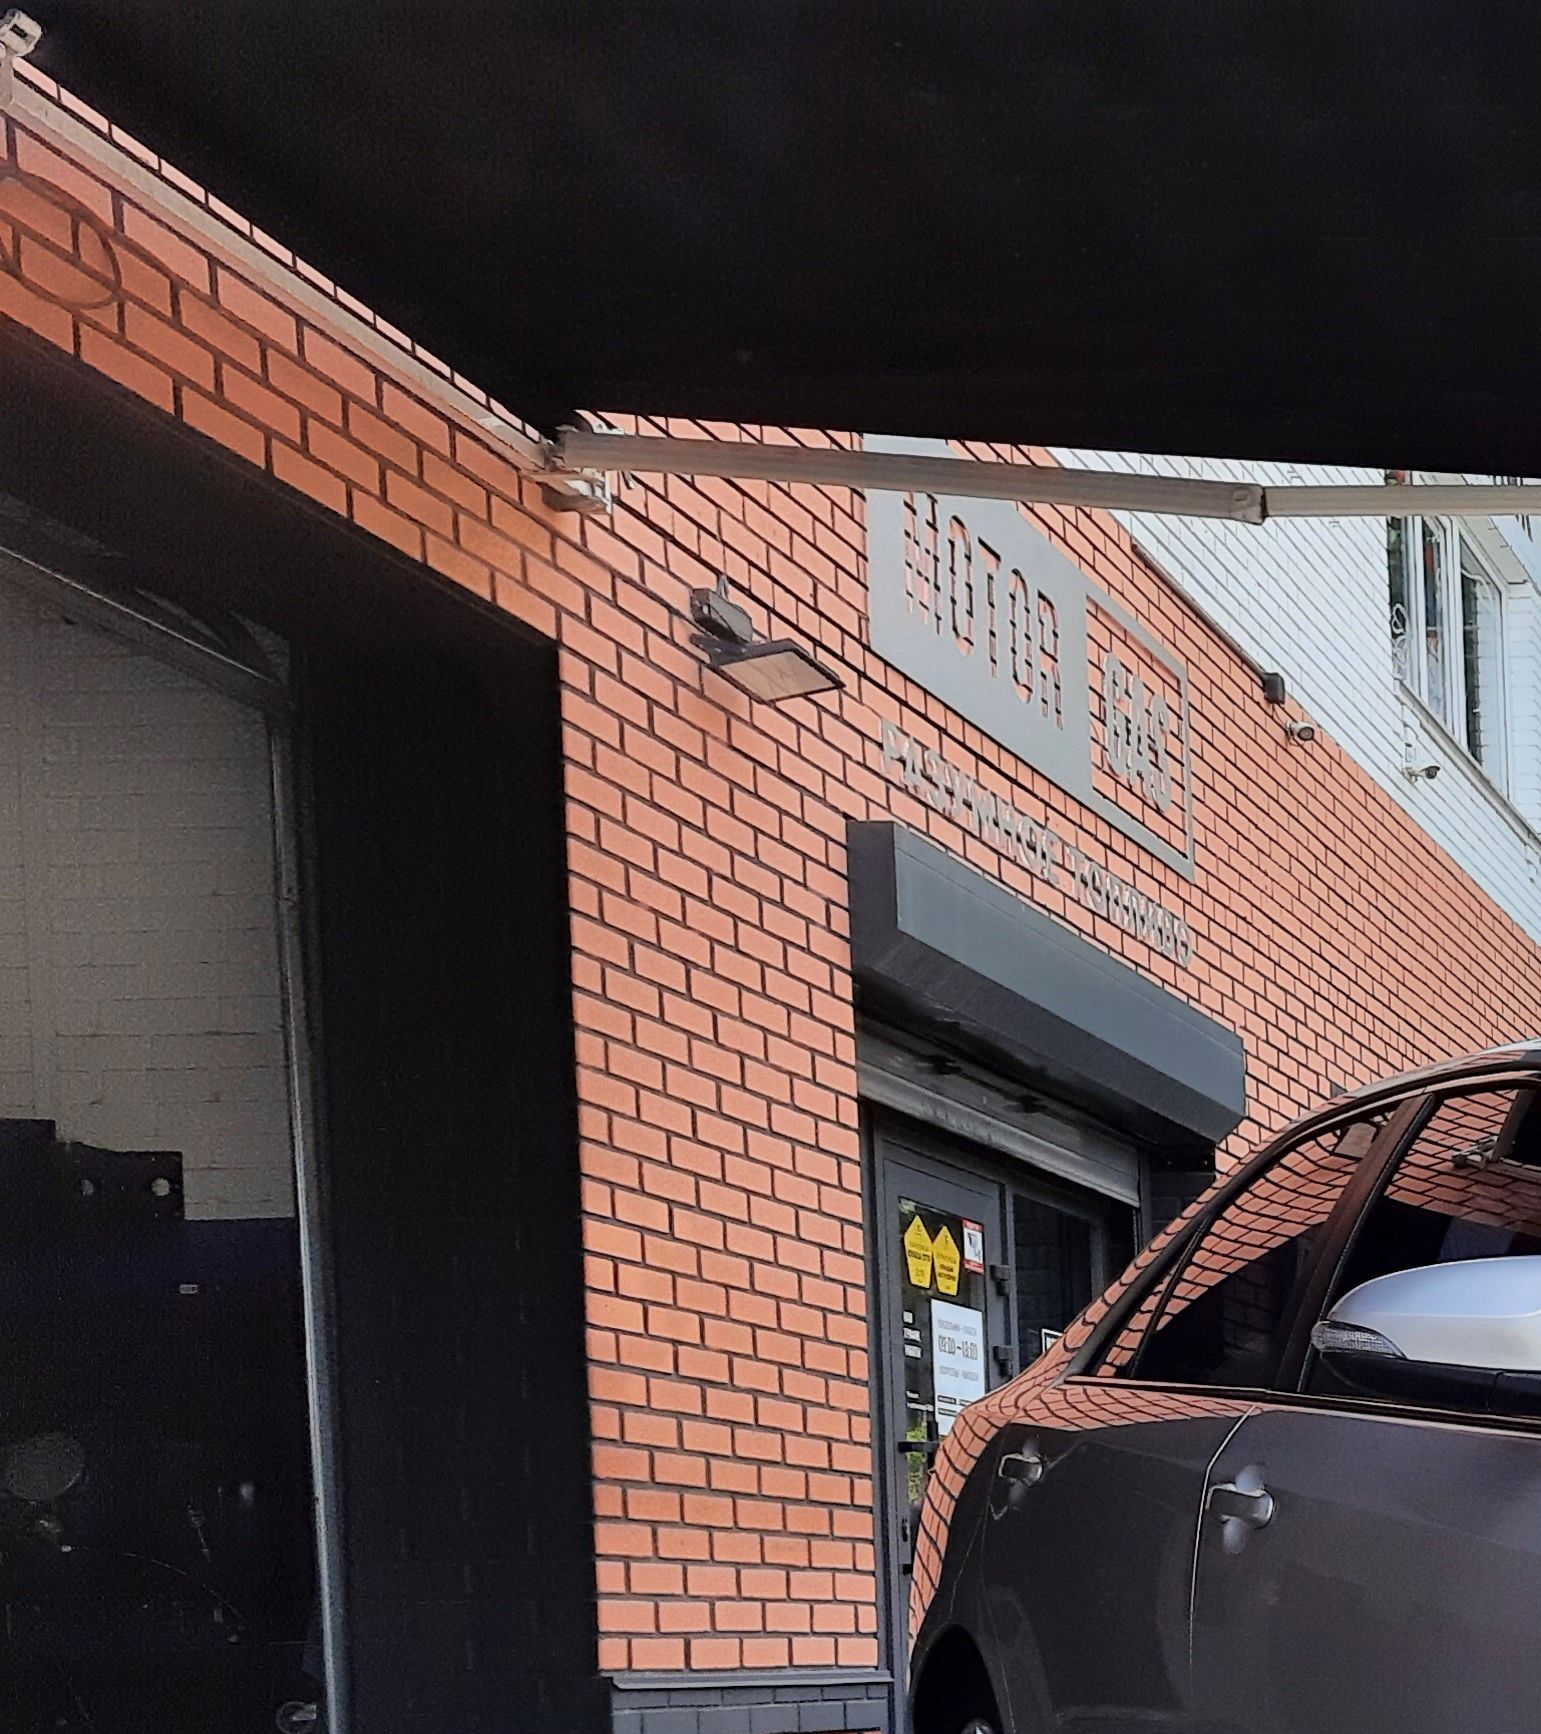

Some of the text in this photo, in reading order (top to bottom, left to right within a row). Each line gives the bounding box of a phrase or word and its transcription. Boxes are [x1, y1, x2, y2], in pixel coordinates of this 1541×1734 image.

[903, 491, 1064, 731] MOTOR
[880, 717, 1193, 968] РАЗУМНОЕ ТОПЛИВО
[1104, 651, 1172, 814] GAS
